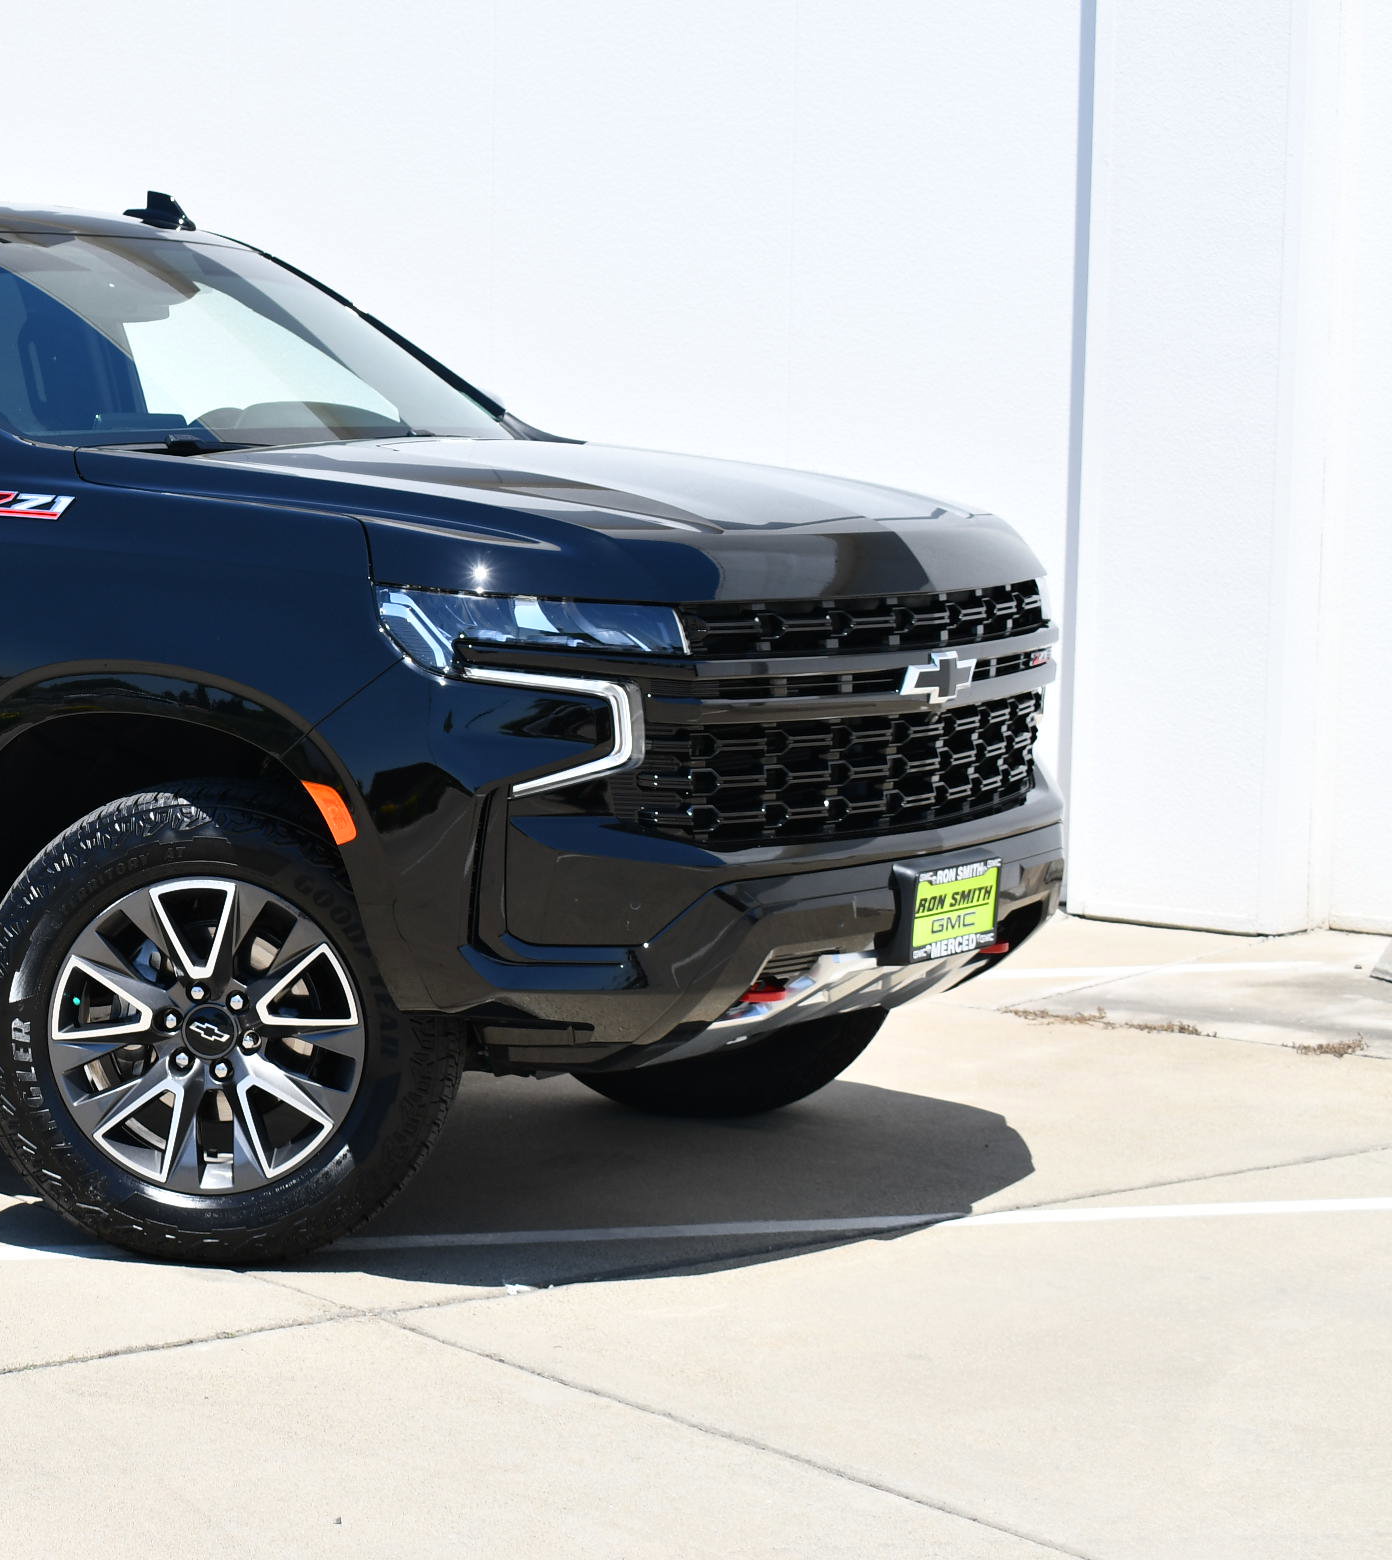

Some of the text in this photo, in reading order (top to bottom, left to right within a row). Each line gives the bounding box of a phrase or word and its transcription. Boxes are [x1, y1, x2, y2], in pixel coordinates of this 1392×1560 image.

[936, 867, 957, 885] RON
[957, 862, 984, 881] SMITH
[916, 885, 993, 914] RON SMITH
[931, 912, 976, 934] GMC
[931, 934, 977, 959] MERCED
